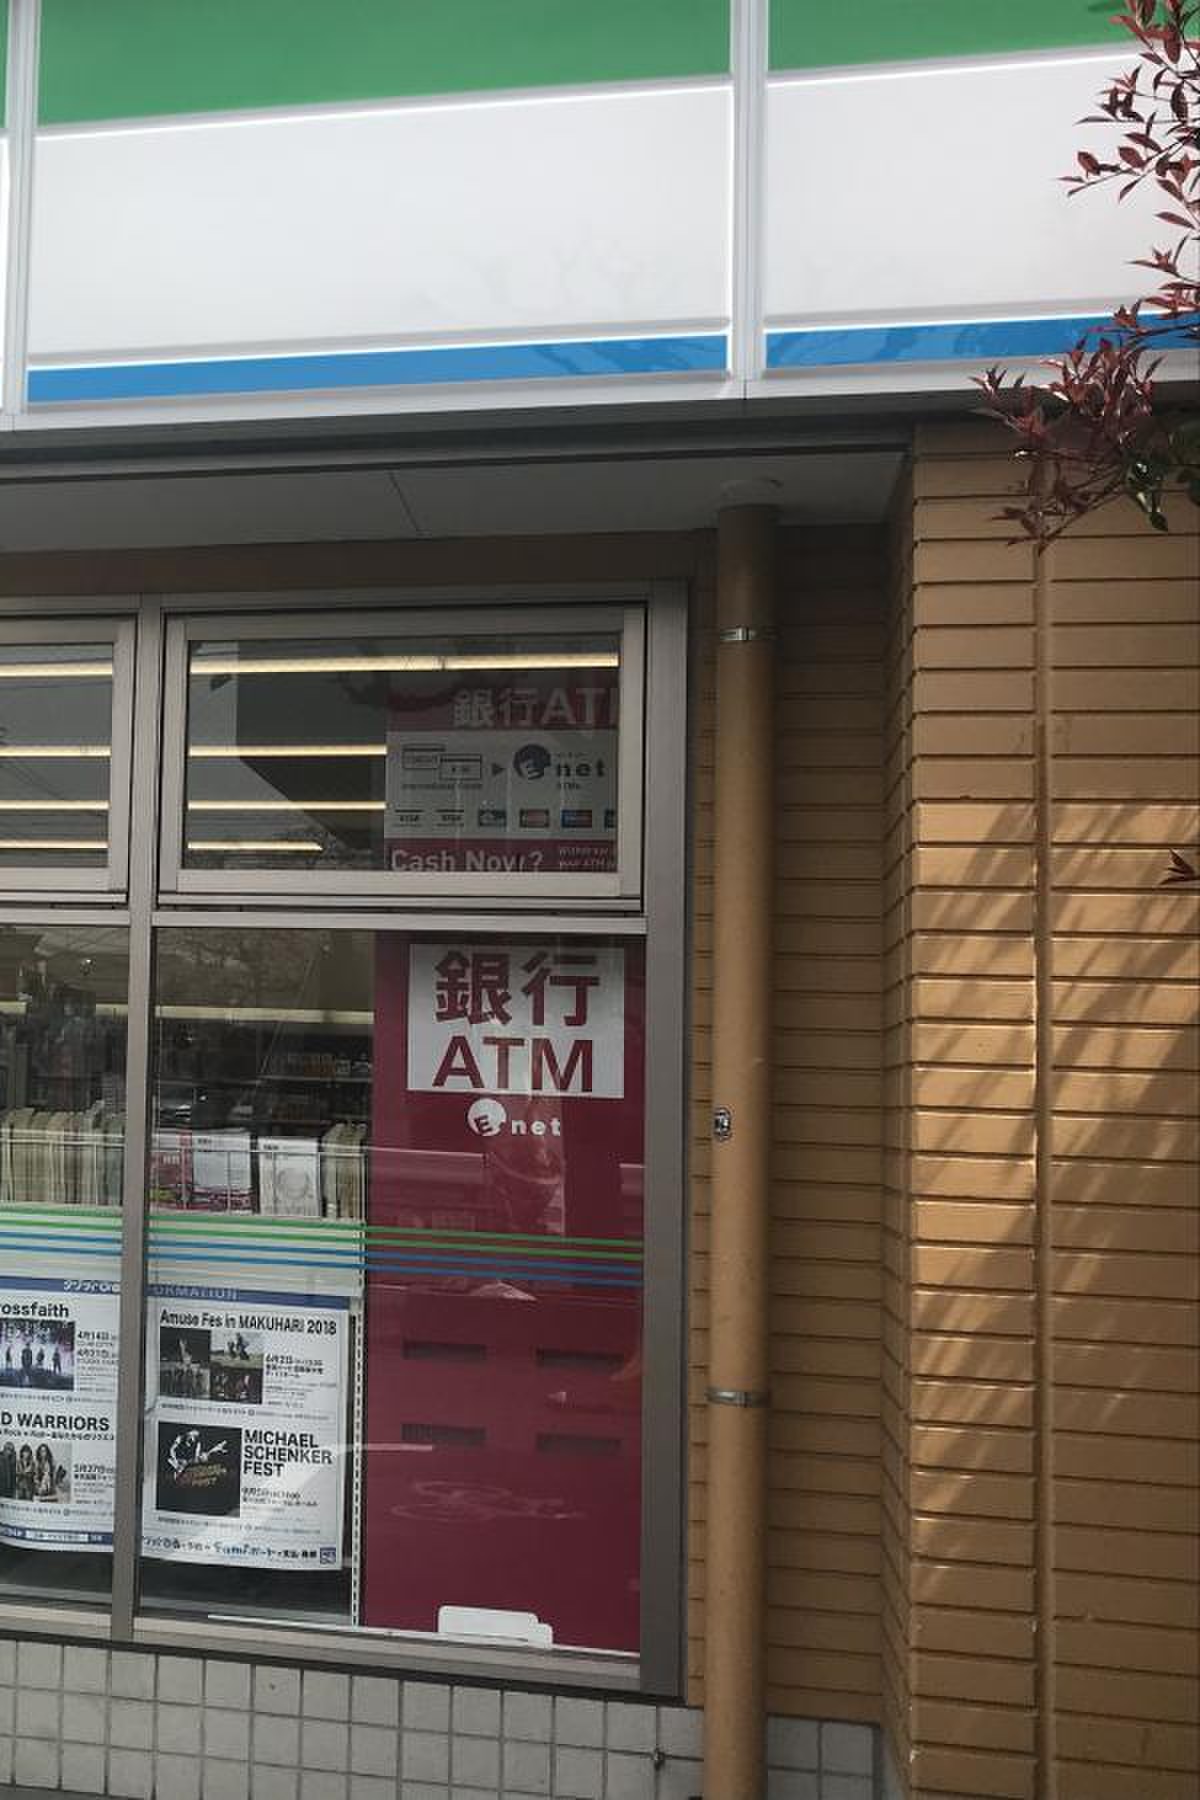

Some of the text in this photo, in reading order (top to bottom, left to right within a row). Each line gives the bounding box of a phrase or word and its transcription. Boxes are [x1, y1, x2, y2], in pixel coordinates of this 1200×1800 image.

[453, 687, 619, 728] 銀行AT
[390, 851, 456, 872] Cash
[434, 951, 600, 1026] 銀行
[432, 1035, 593, 1092] ATM
[160, 1309, 199, 1327] Amuse
[201, 1313, 223, 1327] Fes
[239, 1315, 304, 1333] MAKUHARI
[306, 1320, 337, 1335] 2018
[16, 1413, 110, 1431] WARRIORS
[244, 1429, 319, 1448] MICHAEL
[243, 1446, 333, 1465] SCHENKER
[243, 1461, 285, 1477] FEST
